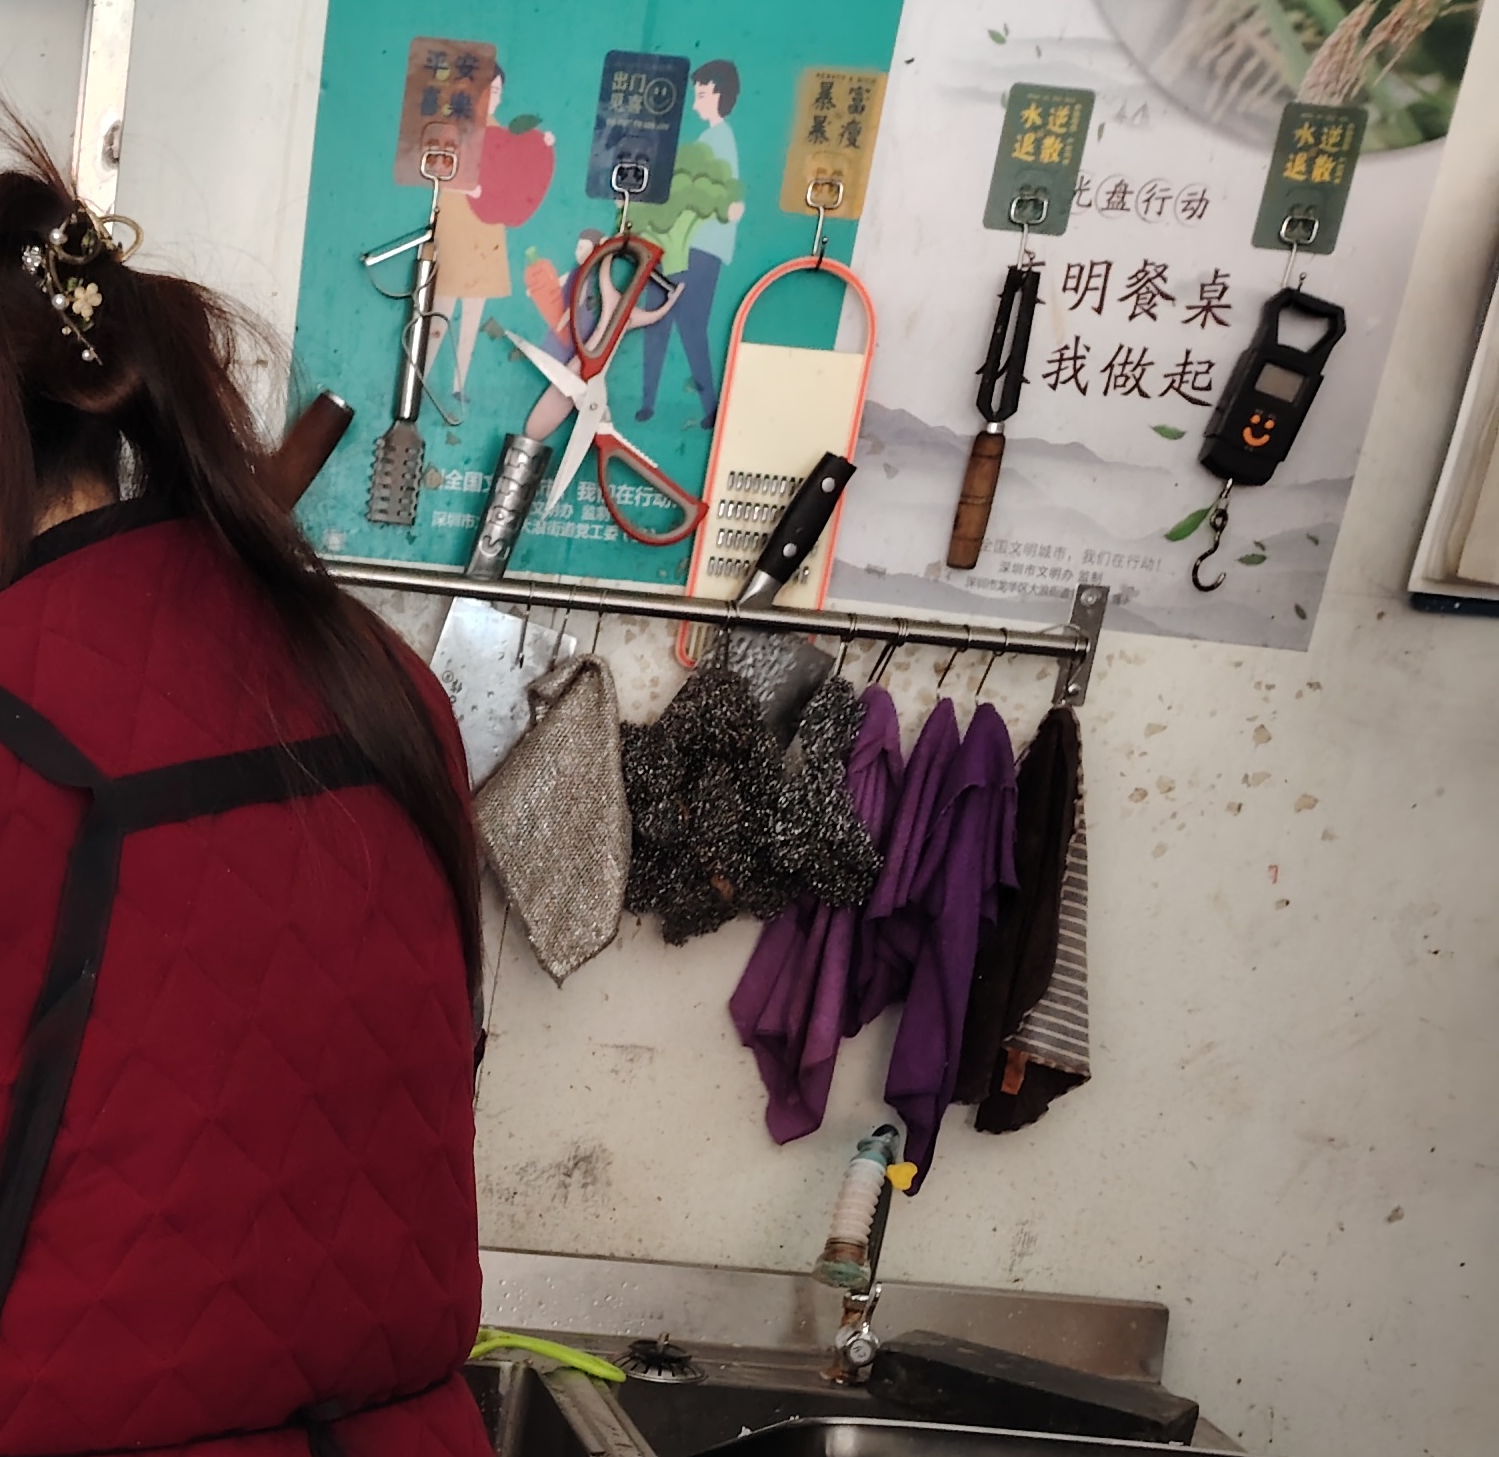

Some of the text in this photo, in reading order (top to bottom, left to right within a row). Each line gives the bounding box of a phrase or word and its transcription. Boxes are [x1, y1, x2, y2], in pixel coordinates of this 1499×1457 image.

[424, 50, 481, 82] 平安
[611, 70, 647, 93] 出门
[812, 81, 870, 115] 暴富
[1019, 102, 1071, 135] 水逆
[1293, 121, 1344, 154] 水逆
